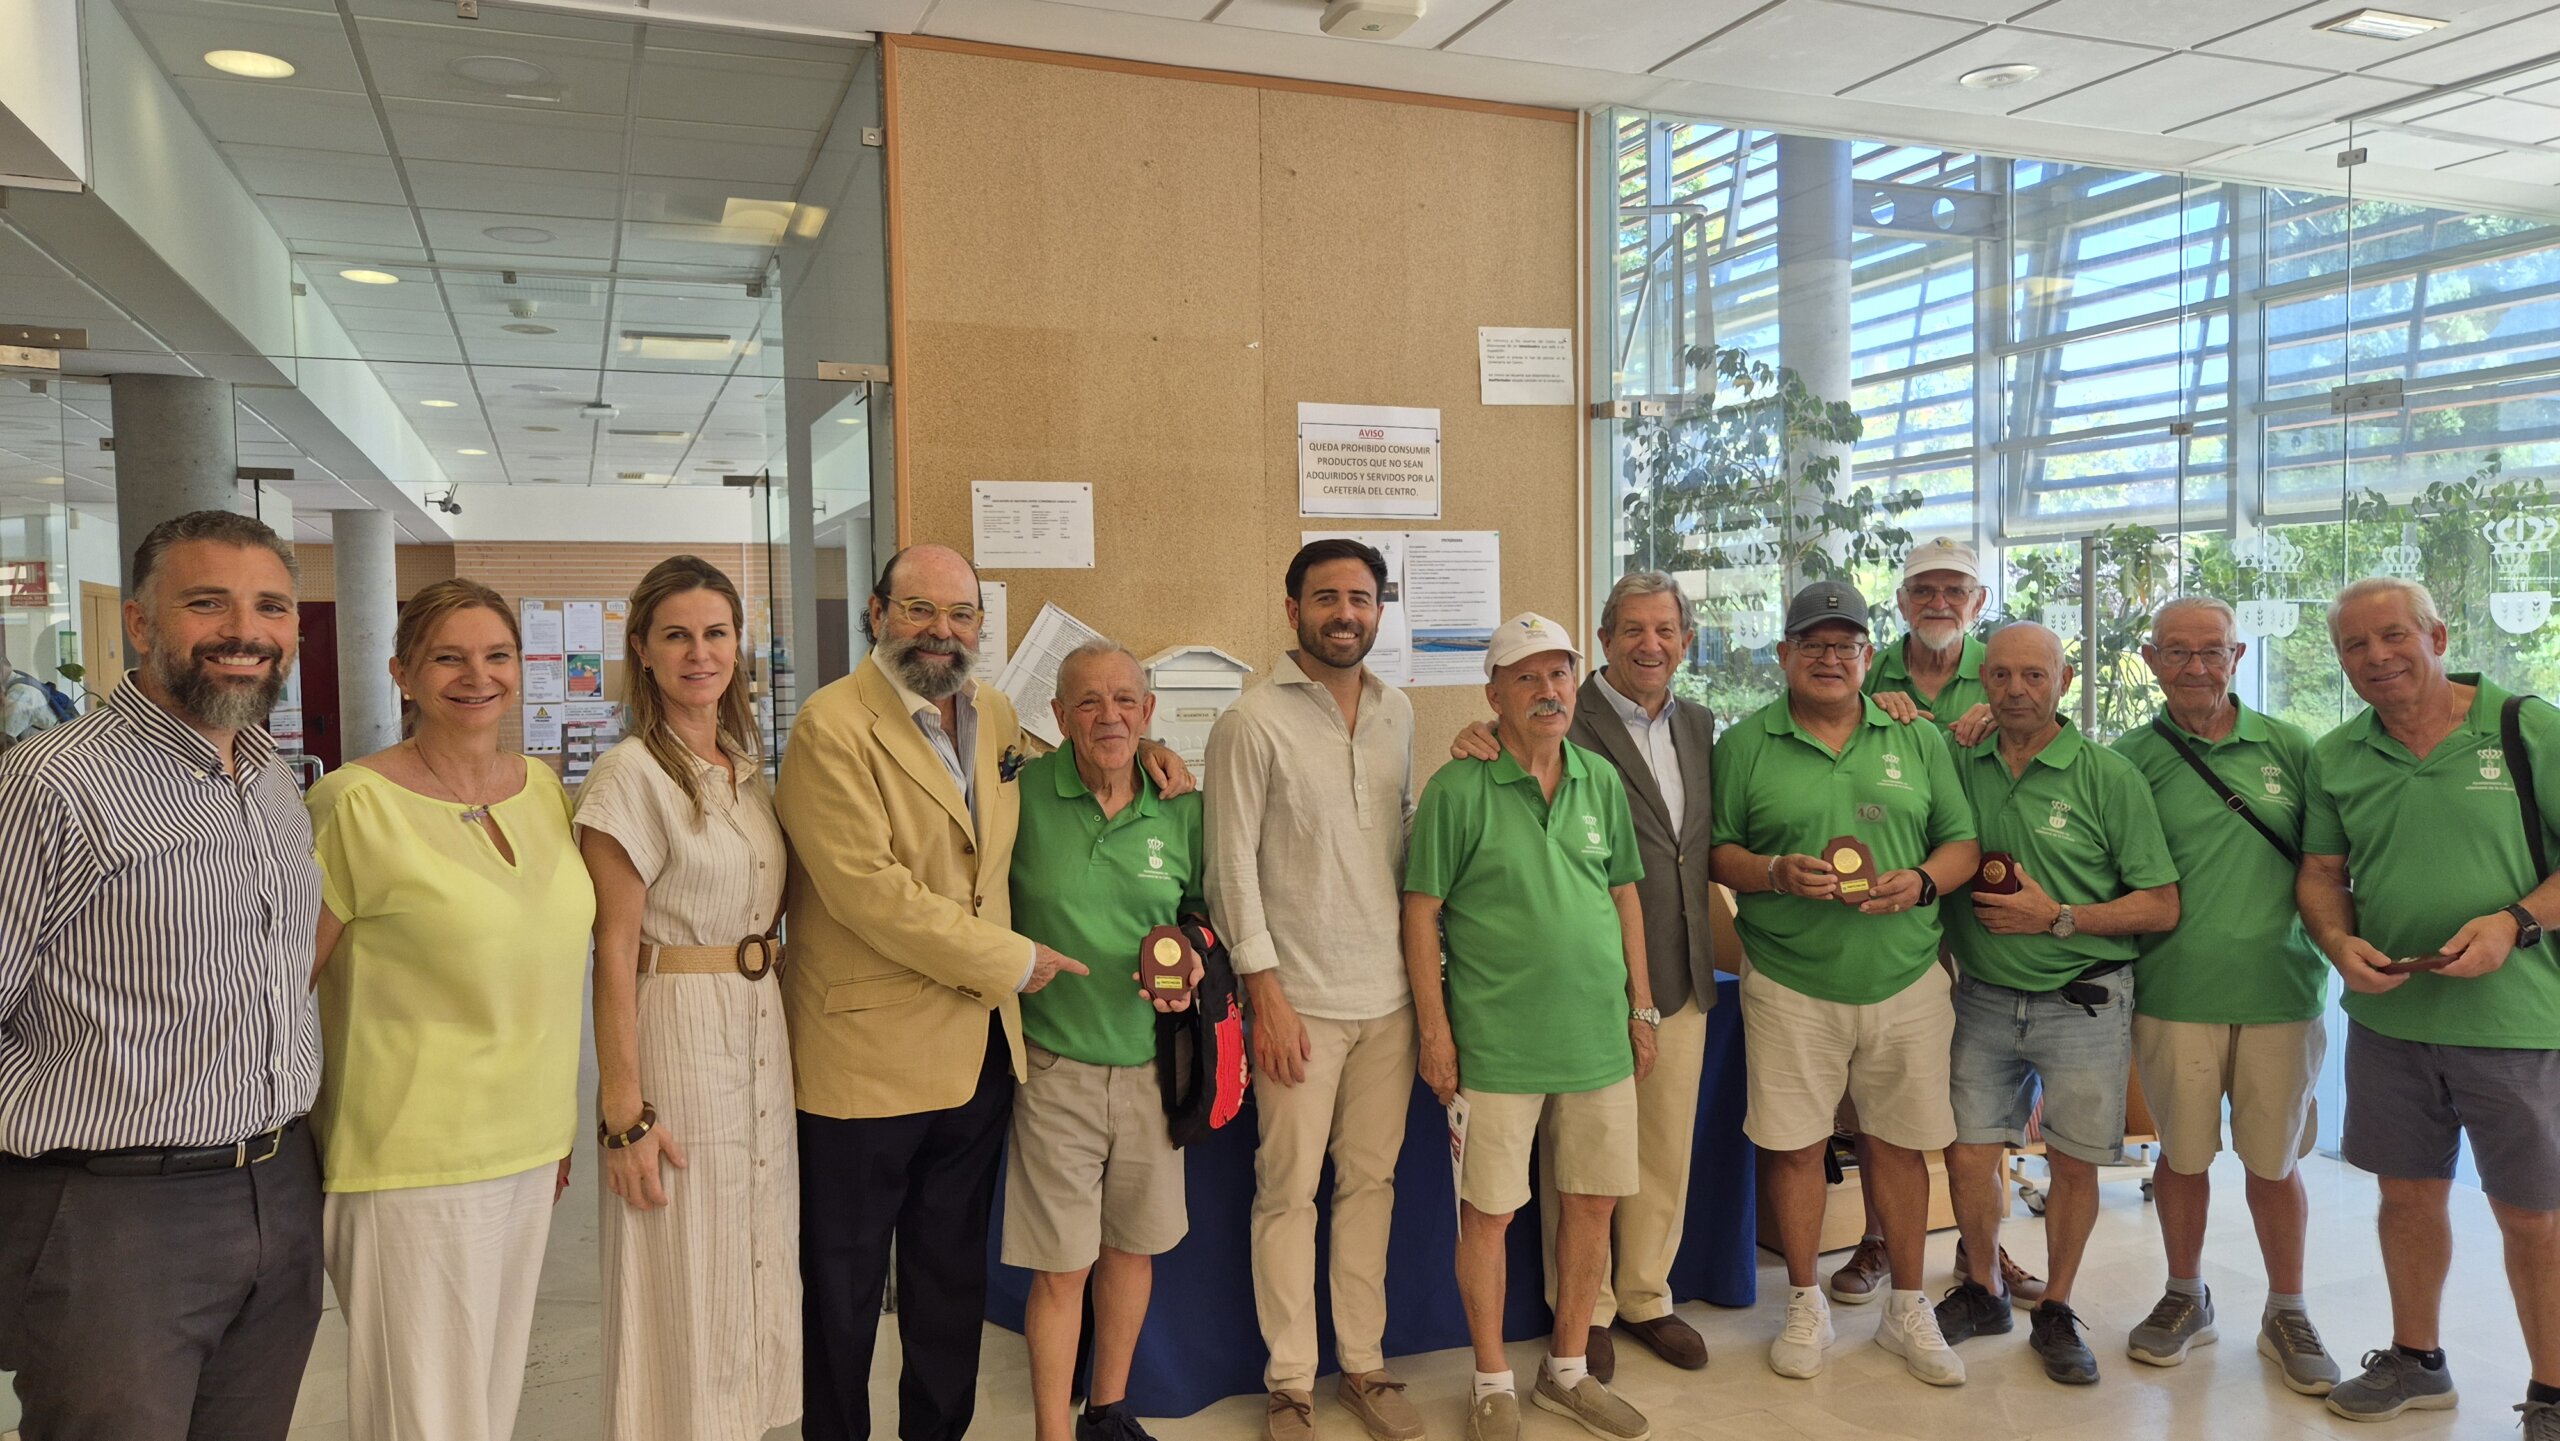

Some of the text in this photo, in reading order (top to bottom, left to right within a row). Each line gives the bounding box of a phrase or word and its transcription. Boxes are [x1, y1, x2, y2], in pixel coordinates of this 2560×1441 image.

[1359, 429, 1384, 439] AVISO
[1309, 443, 1430, 454] QUEDA PROHIBIDO CONSUMIR
[1317, 458, 1367, 466] PRODUCTOS
[1369, 459, 1386, 467] QUE
[1403, 460, 1423, 468] SEAN
[1306, 472, 1358, 481] ADQUIRIDOS
[1367, 473, 1405, 482] SERVIDOS
[1407, 474, 1423, 482] POR
[1323, 485, 1419, 496] CAFETERÍA DEL CENTRO.
